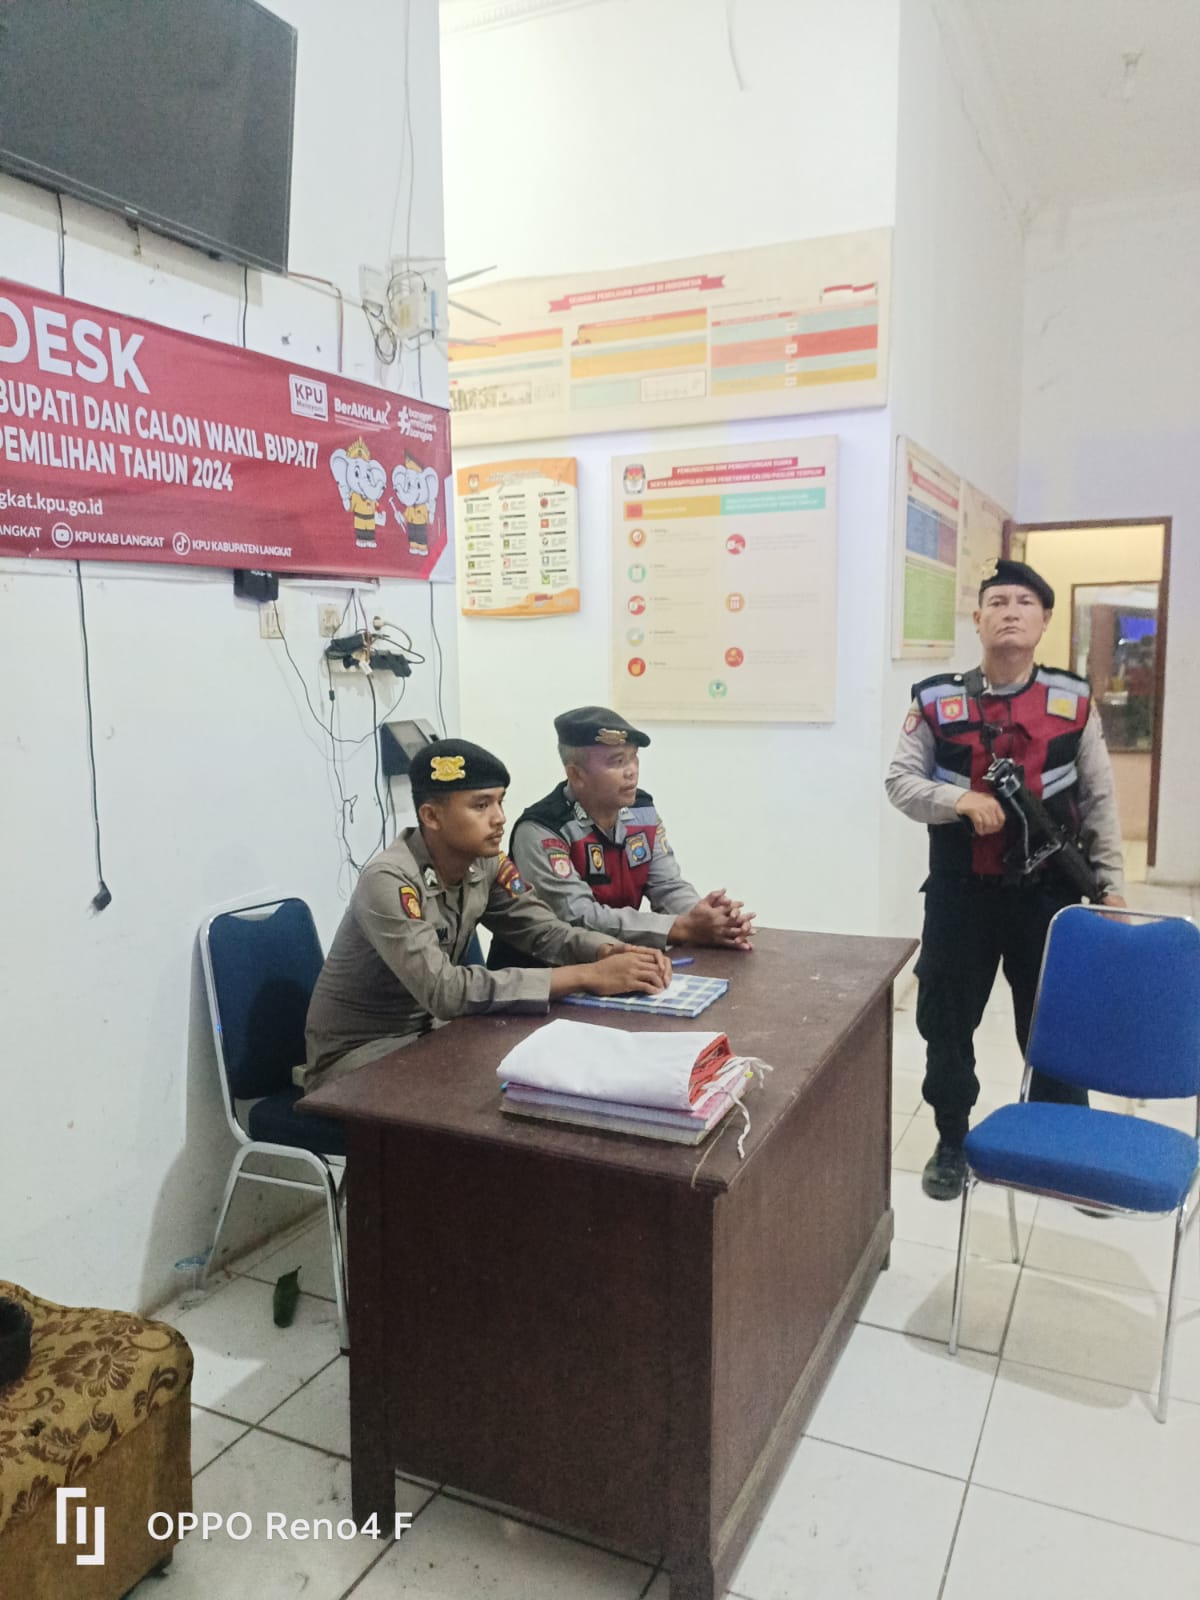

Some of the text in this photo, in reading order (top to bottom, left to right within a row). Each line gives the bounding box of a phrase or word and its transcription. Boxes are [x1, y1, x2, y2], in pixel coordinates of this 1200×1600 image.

[0, 297, 151, 394] DESK
[294, 382, 323, 404] KPU
[334, 397, 391, 425] BerAKHLAK
[83, 395, 131, 436] DAN
[135, 406, 202, 448] CALON
[203, 420, 263, 459] WAKIL
[264, 432, 319, 470] BUPATI
[0, 425, 234, 491] EMILIHAN TAHUN 2024
[75, 530, 97, 543] KPU
[98, 532, 119, 545] KAB
[120, 534, 165, 548] LANGKAT
[192, 539, 293, 557] KPU KABUPATEN LANGKAT
